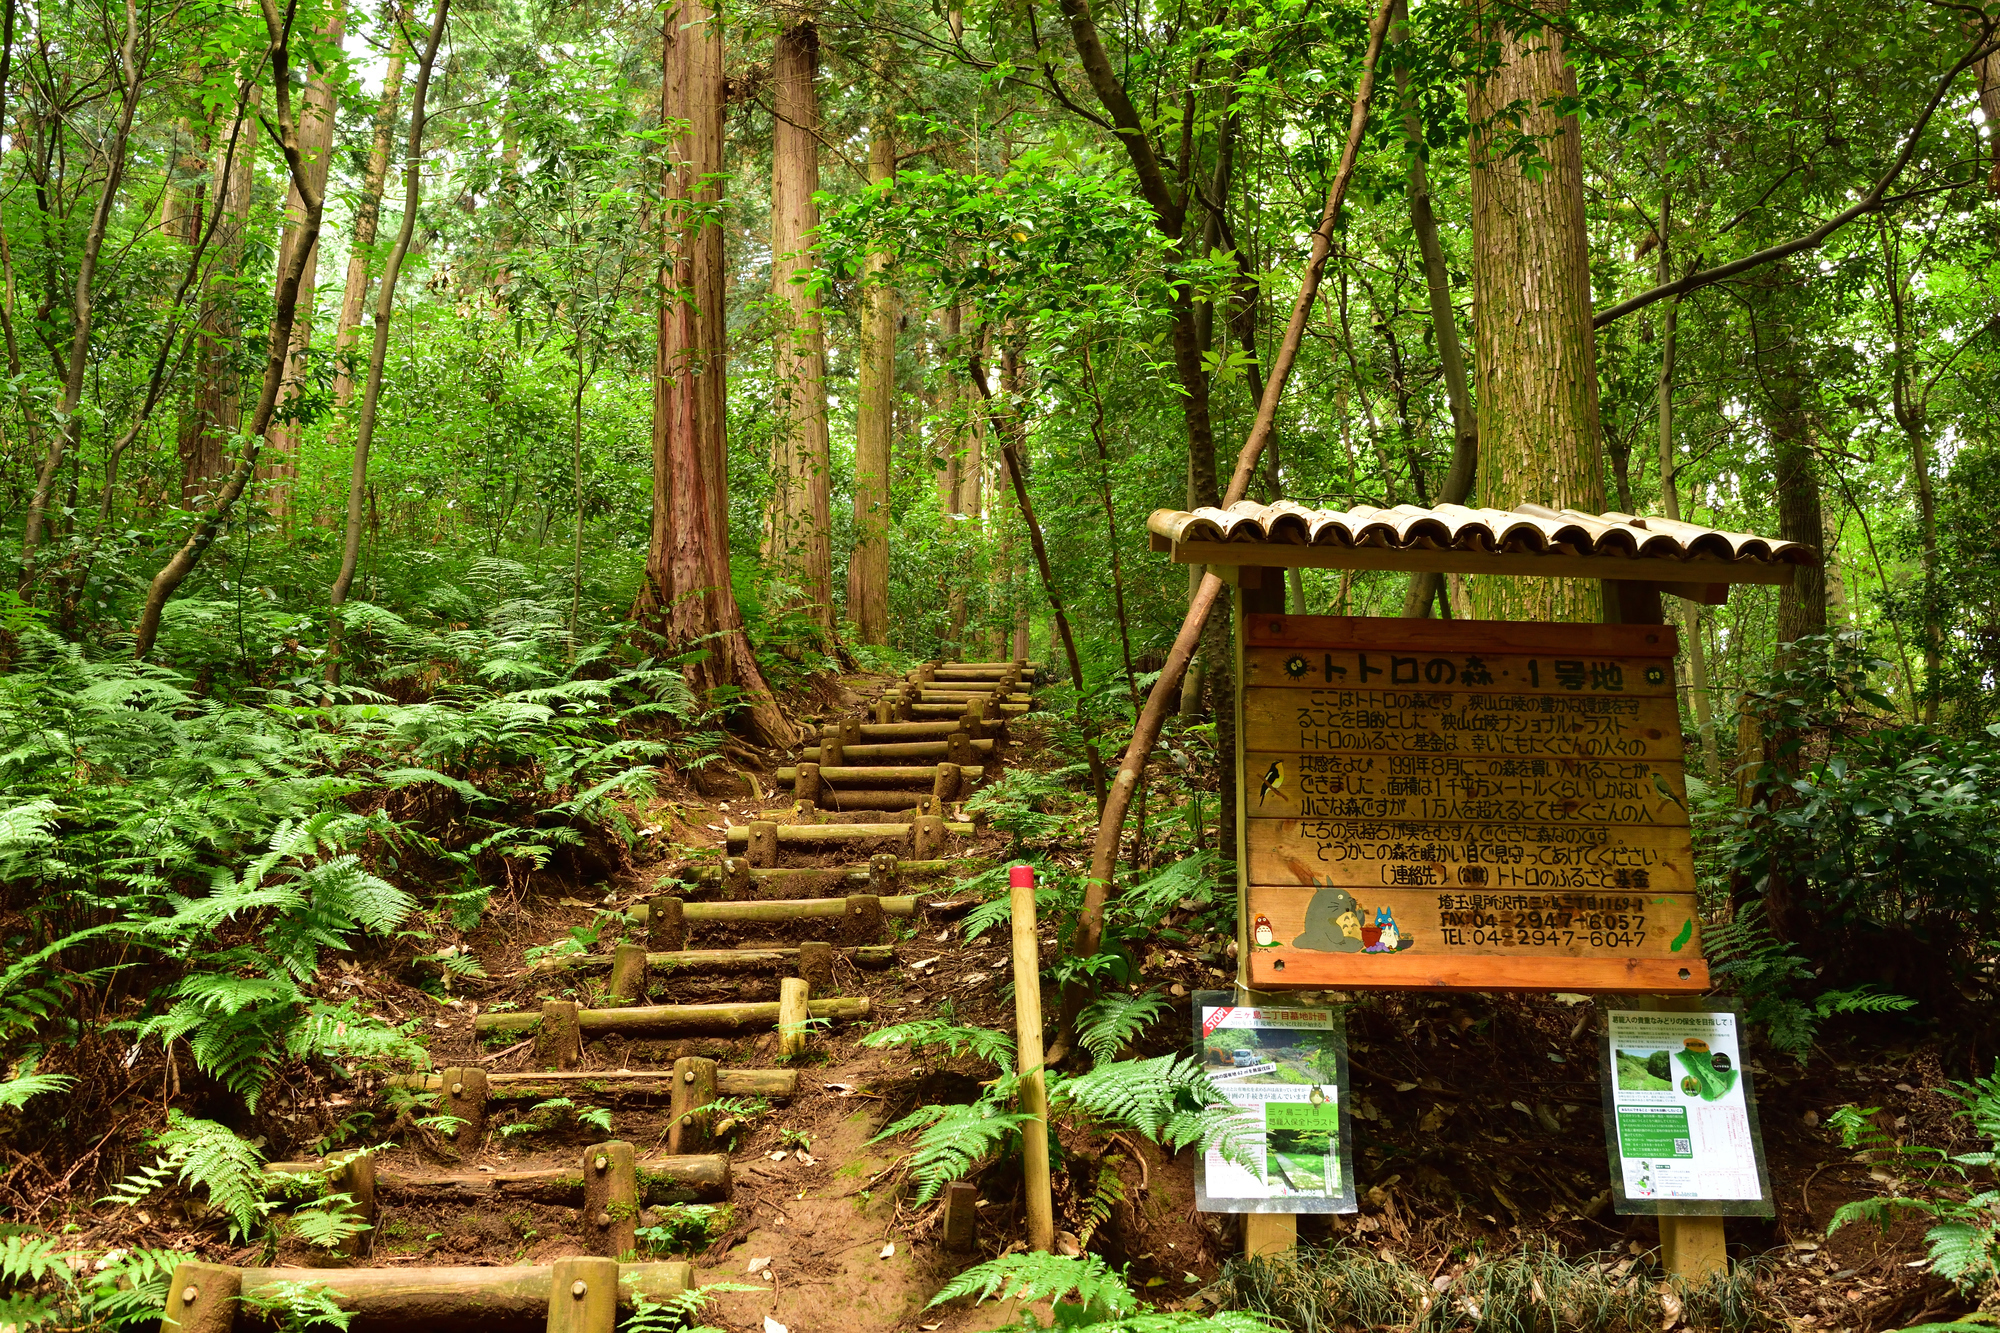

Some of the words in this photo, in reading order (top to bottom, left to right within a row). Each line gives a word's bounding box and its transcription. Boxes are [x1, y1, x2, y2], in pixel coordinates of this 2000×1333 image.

[1325, 653, 1623, 691] トトロの森・1号地
[1311, 690, 1639, 714] ここはトトロの森です。狭山丘陵の豊かな環境を守
[1301, 730, 1646, 756] トトロのふるさと基金は、幸いにもたくさんの人々の
[1299, 756, 1650, 779] 共感をよび、1991年8月にこの森を買い入れることが
[1299, 775, 1650, 800] できました。面積は1千平方メートルくらいしかない
[1301, 798, 1654, 822] 小さな森ですが、1万人を超えるとてもたくさんの人
[1301, 822, 1624, 845] たちの気持ちが実をむすんでできた森なのです。
[1317, 841, 1668, 867] どうかこの森を暖かい目で見守ってあげてください。
[1443, 928, 1646, 947] TEL:04-2947-6047
[1206, 1007, 1228, 1030] STOP!
[1234, 1009, 1327, 1022] 三ヶ島二丁目墓地計画
[1268, 1108, 1320, 1117] 三ヶ島二丁目
